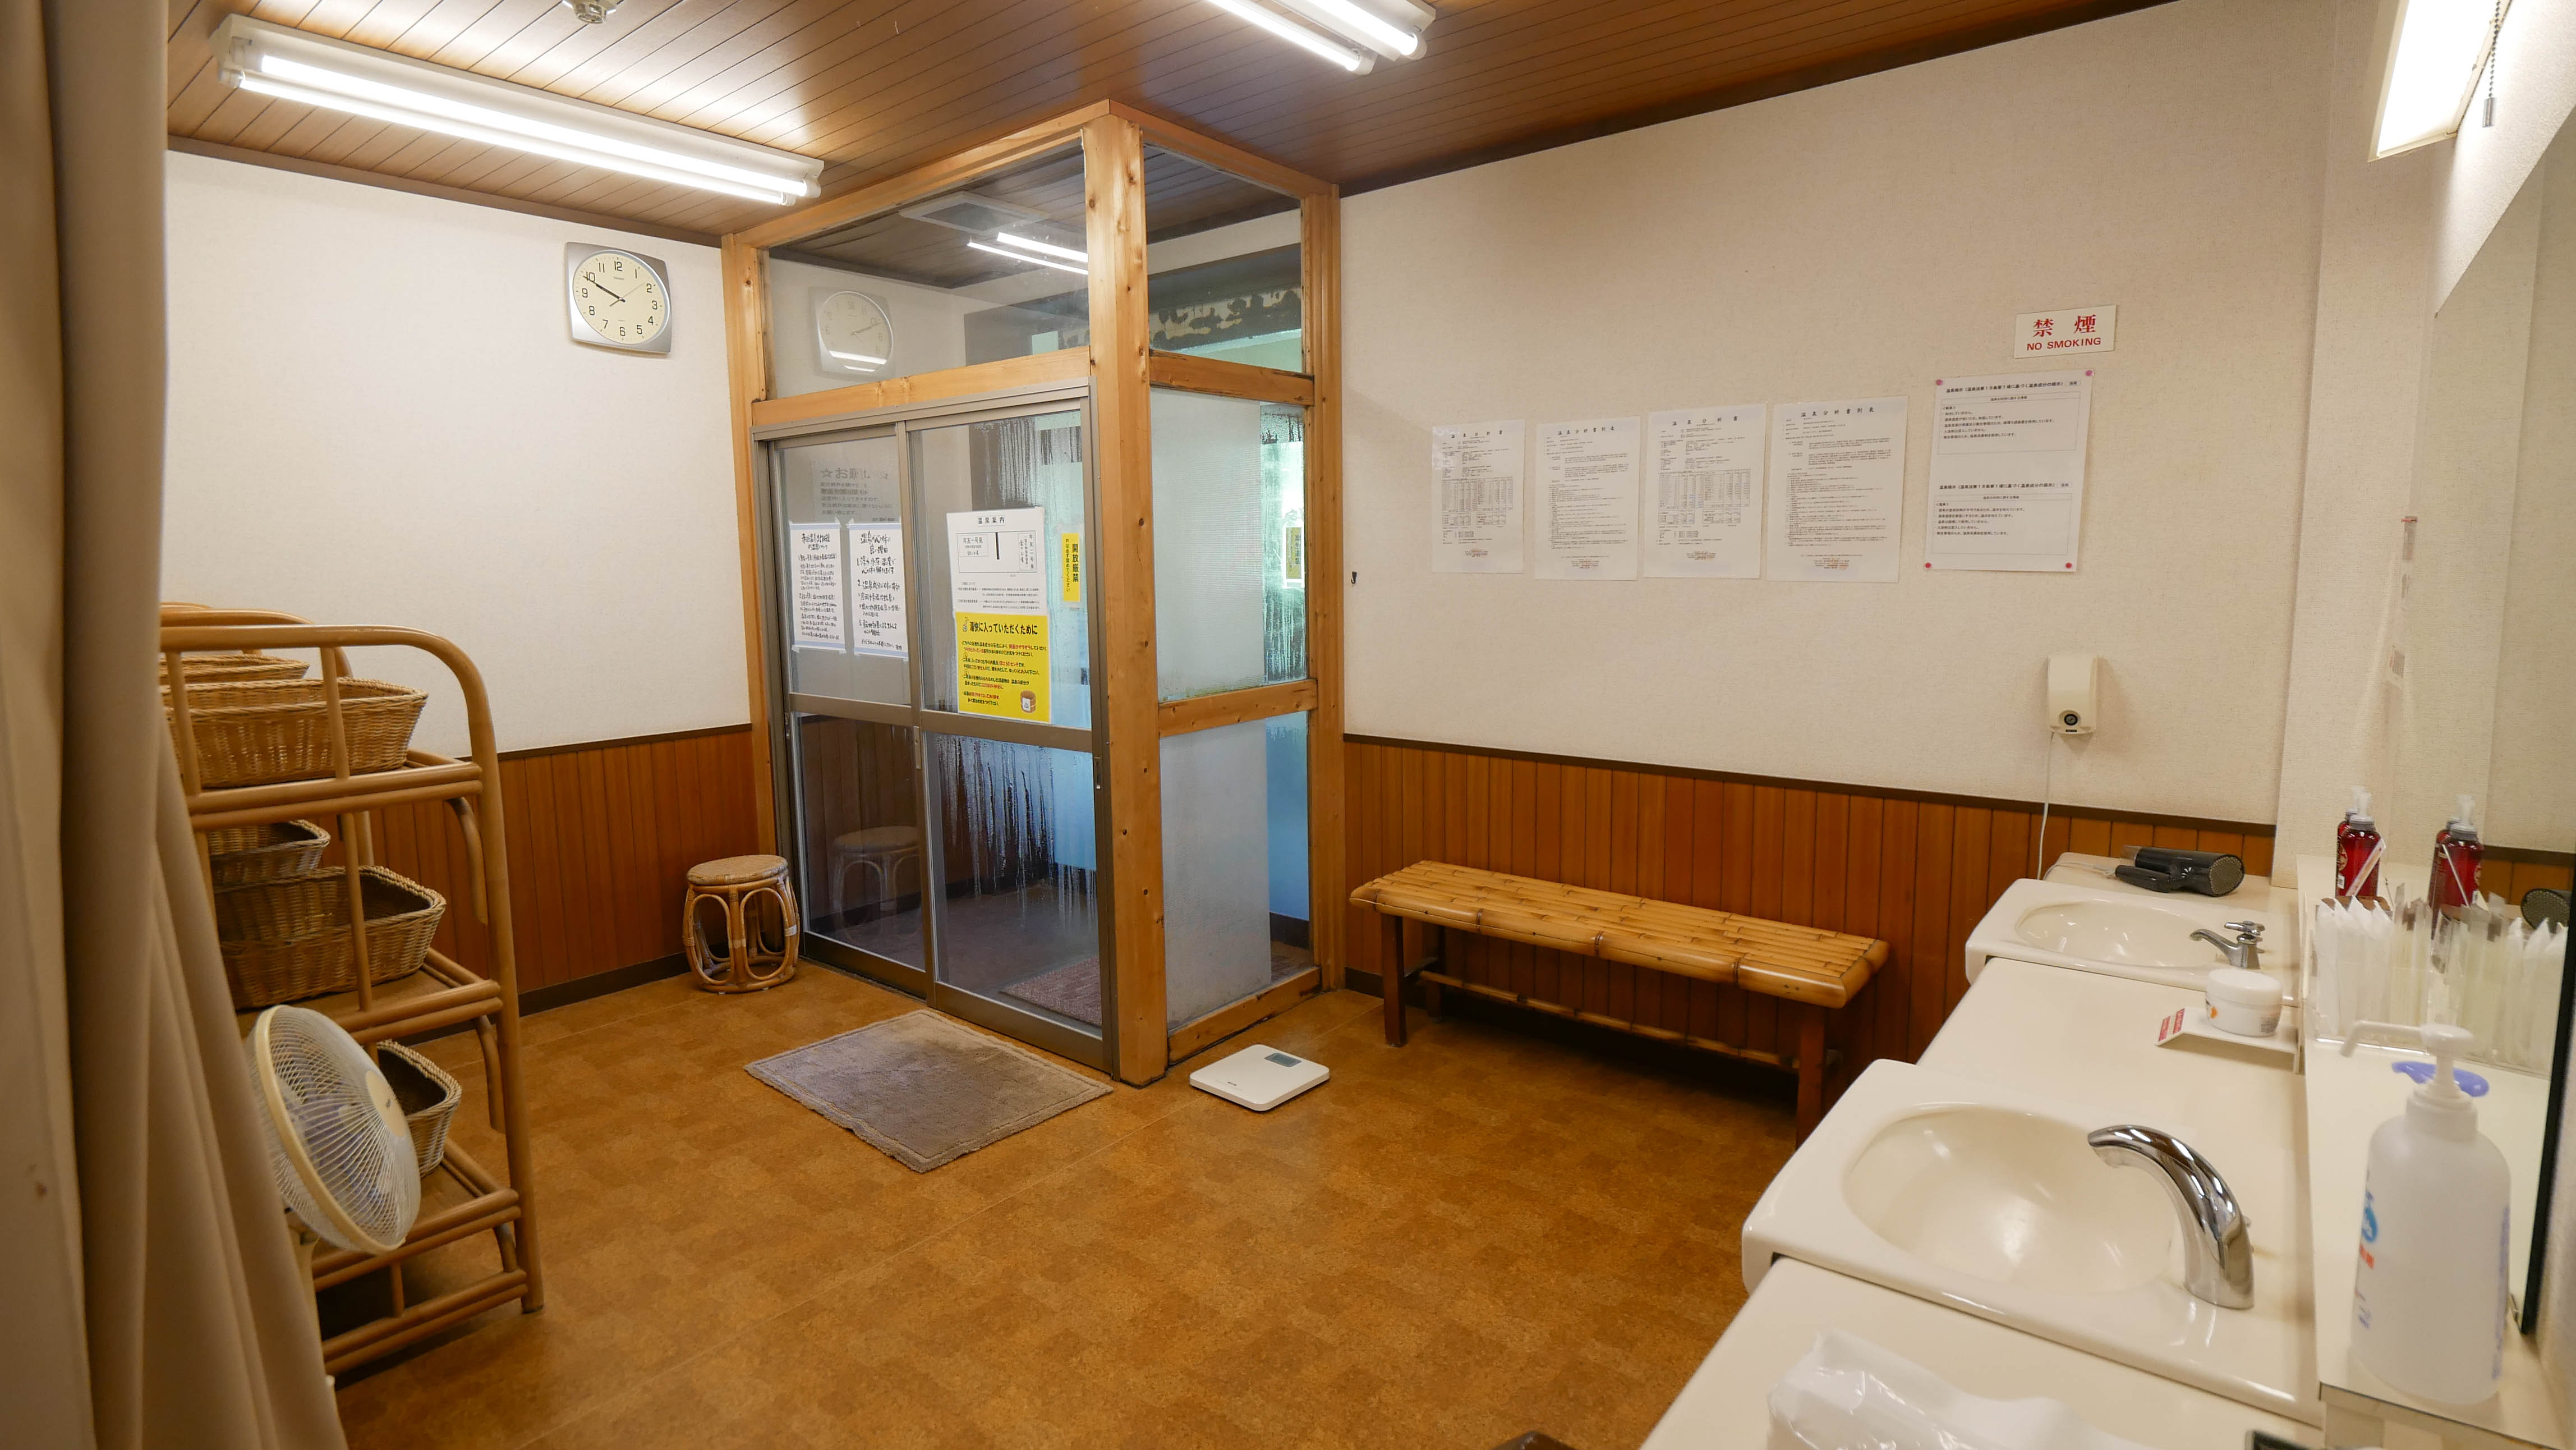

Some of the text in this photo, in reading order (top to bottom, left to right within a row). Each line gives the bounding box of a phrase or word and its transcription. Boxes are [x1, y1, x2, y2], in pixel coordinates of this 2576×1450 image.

[599, 263, 605, 273] 11
[614, 261, 623, 272] 12
[586, 272, 595, 282] 10
[582, 288, 588, 298] 9
[646, 283, 652, 293] 2
[652, 300, 657, 310] 3
[589, 306, 595, 316] 8
[602, 319, 608, 329] 7
[648, 316, 654, 325] 4
[2032, 314, 2096, 337] 禁煙
[620, 327, 625, 337] 6
[637, 325, 642, 334] 5
[2027, 337, 2101, 351] NO SMOKING
